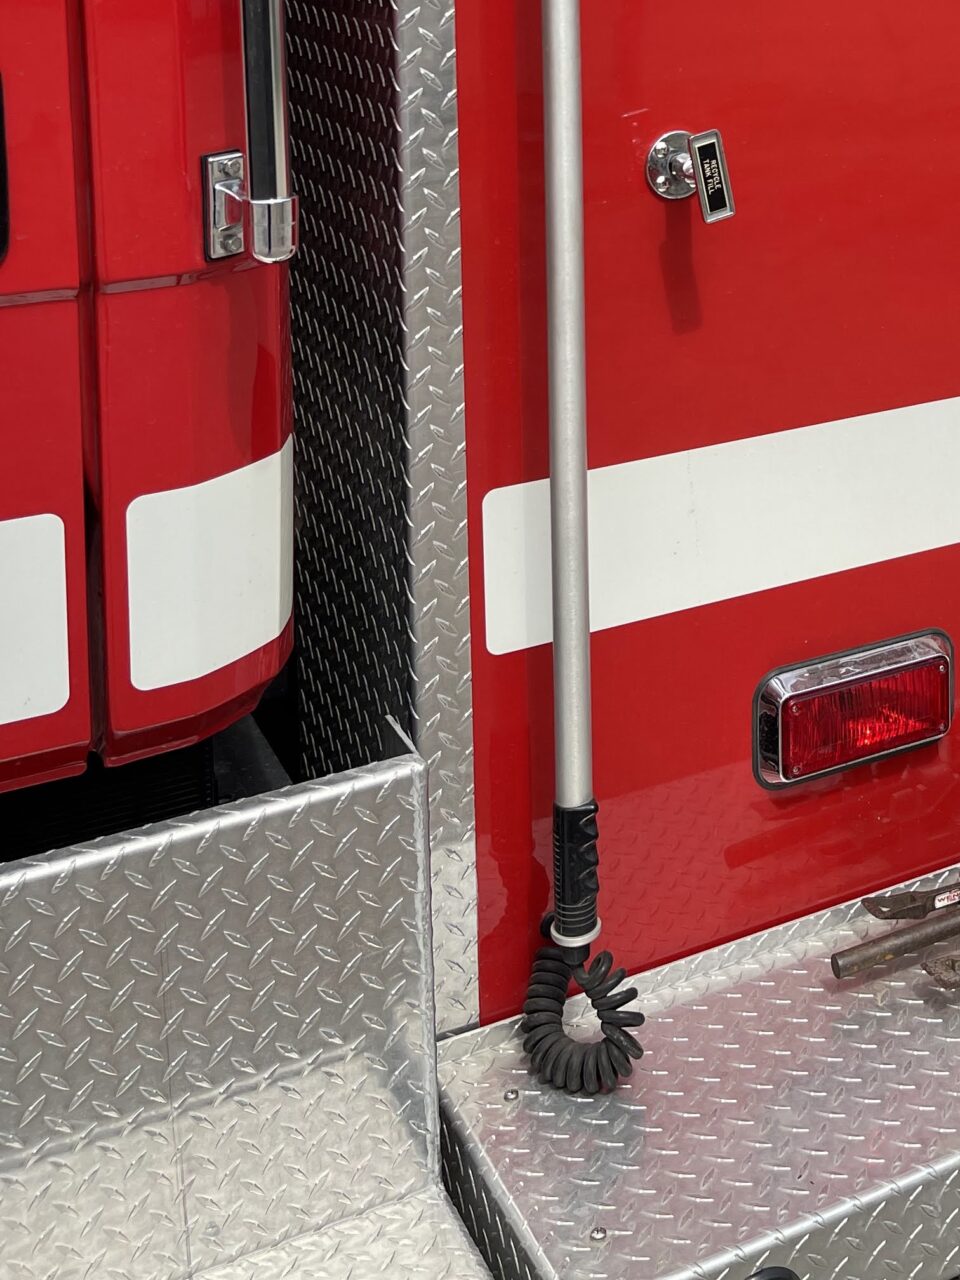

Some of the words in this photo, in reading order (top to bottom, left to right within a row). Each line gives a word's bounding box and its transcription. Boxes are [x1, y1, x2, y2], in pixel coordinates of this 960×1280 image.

[702, 158, 711, 178] TANK
[707, 178, 716, 195] FILL
[710, 159, 722, 190] RECYCLE
